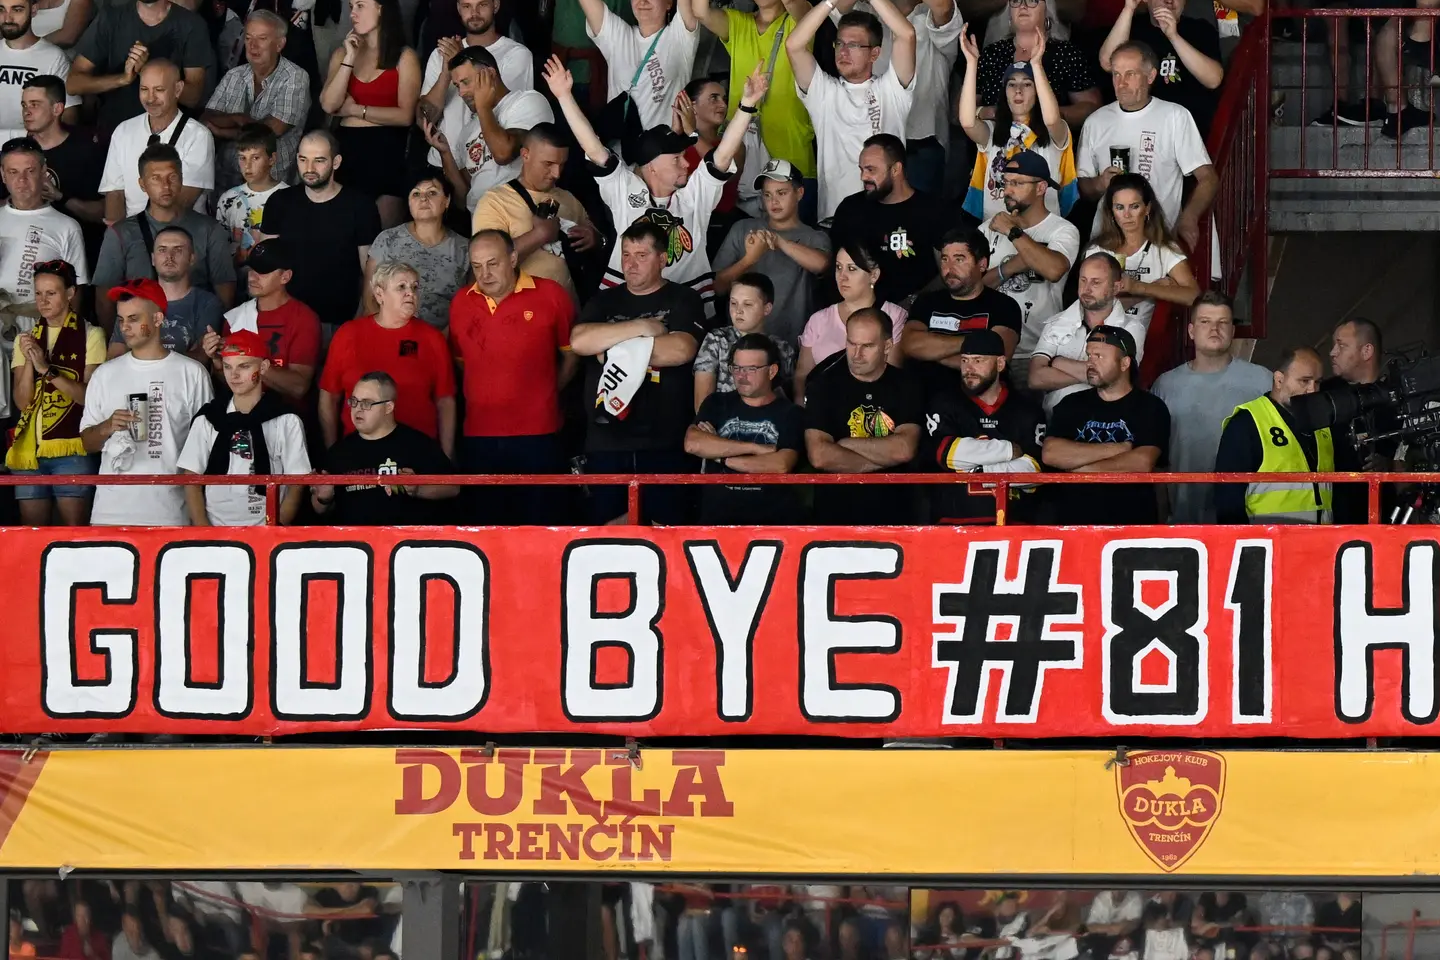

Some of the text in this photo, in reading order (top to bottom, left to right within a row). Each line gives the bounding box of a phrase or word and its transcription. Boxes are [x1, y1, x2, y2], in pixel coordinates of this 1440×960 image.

[1160, 59, 1177, 76] 81
[889, 233, 908, 252] 81
[12, 244, 34, 286] HOSSA
[148, 404, 163, 448] HOSSA
[1269, 426, 1289, 447] 8
[40, 541, 490, 722] GOOD
[561, 538, 903, 723] BYE
[932, 538, 1273, 725] #81
[1134, 752, 1209, 768] HOKEJOVÝ KLUB
[394, 750, 734, 817] DUKLA
[1133, 796, 1207, 817] DUKLA
[452, 813, 675, 863] TRENČÍN
[1149, 832, 1192, 844] TRENČÍN
